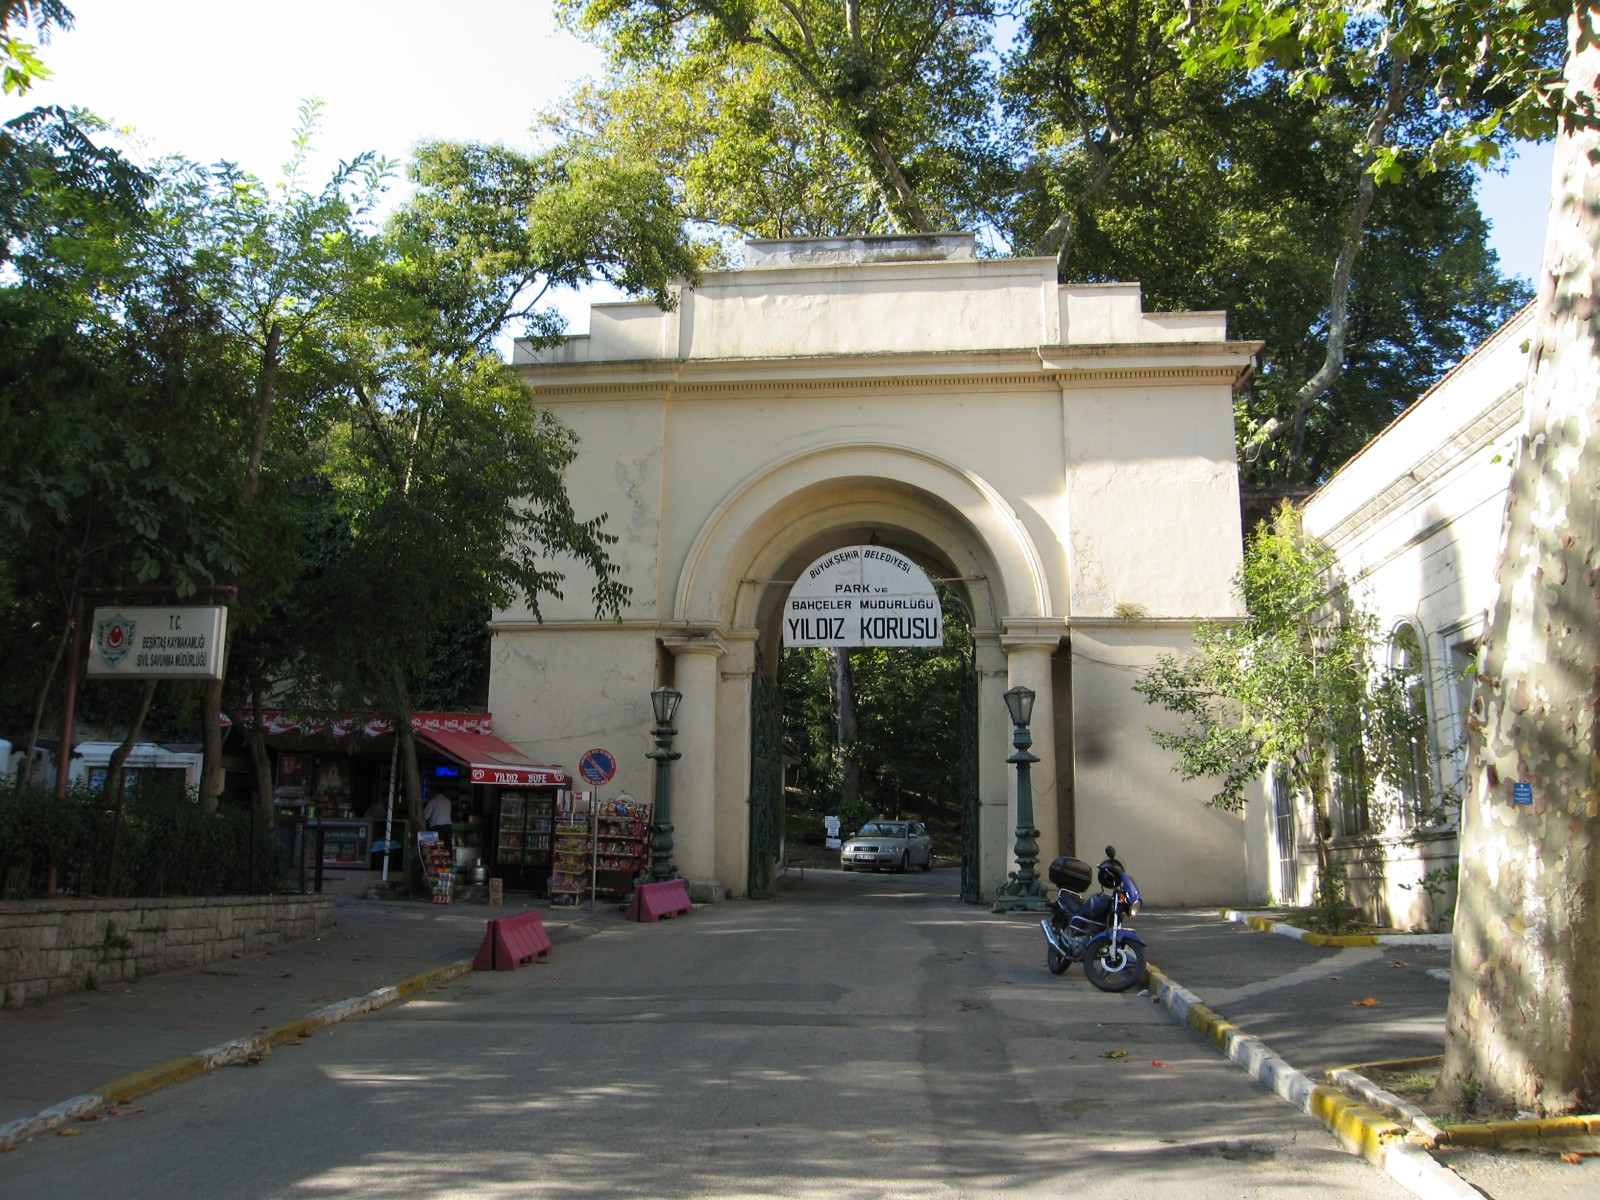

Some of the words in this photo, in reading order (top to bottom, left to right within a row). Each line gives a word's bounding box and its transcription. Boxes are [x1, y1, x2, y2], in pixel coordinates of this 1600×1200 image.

[864, 550, 911, 574] BELEDİYESİ
[835, 584, 870, 593] PARK
[792, 600, 852, 611] BAHÇELER
[860, 598, 934, 609] MÜDÜRLÜĞÜ
[788, 617, 845, 640] YILDIZ
[860, 617, 937, 640] KORUSU
[142, 635, 167, 652] BEŞİKTAŞ
[150, 653, 174, 667] SAVUNMA
[494, 772, 518, 783] YILDIZ
